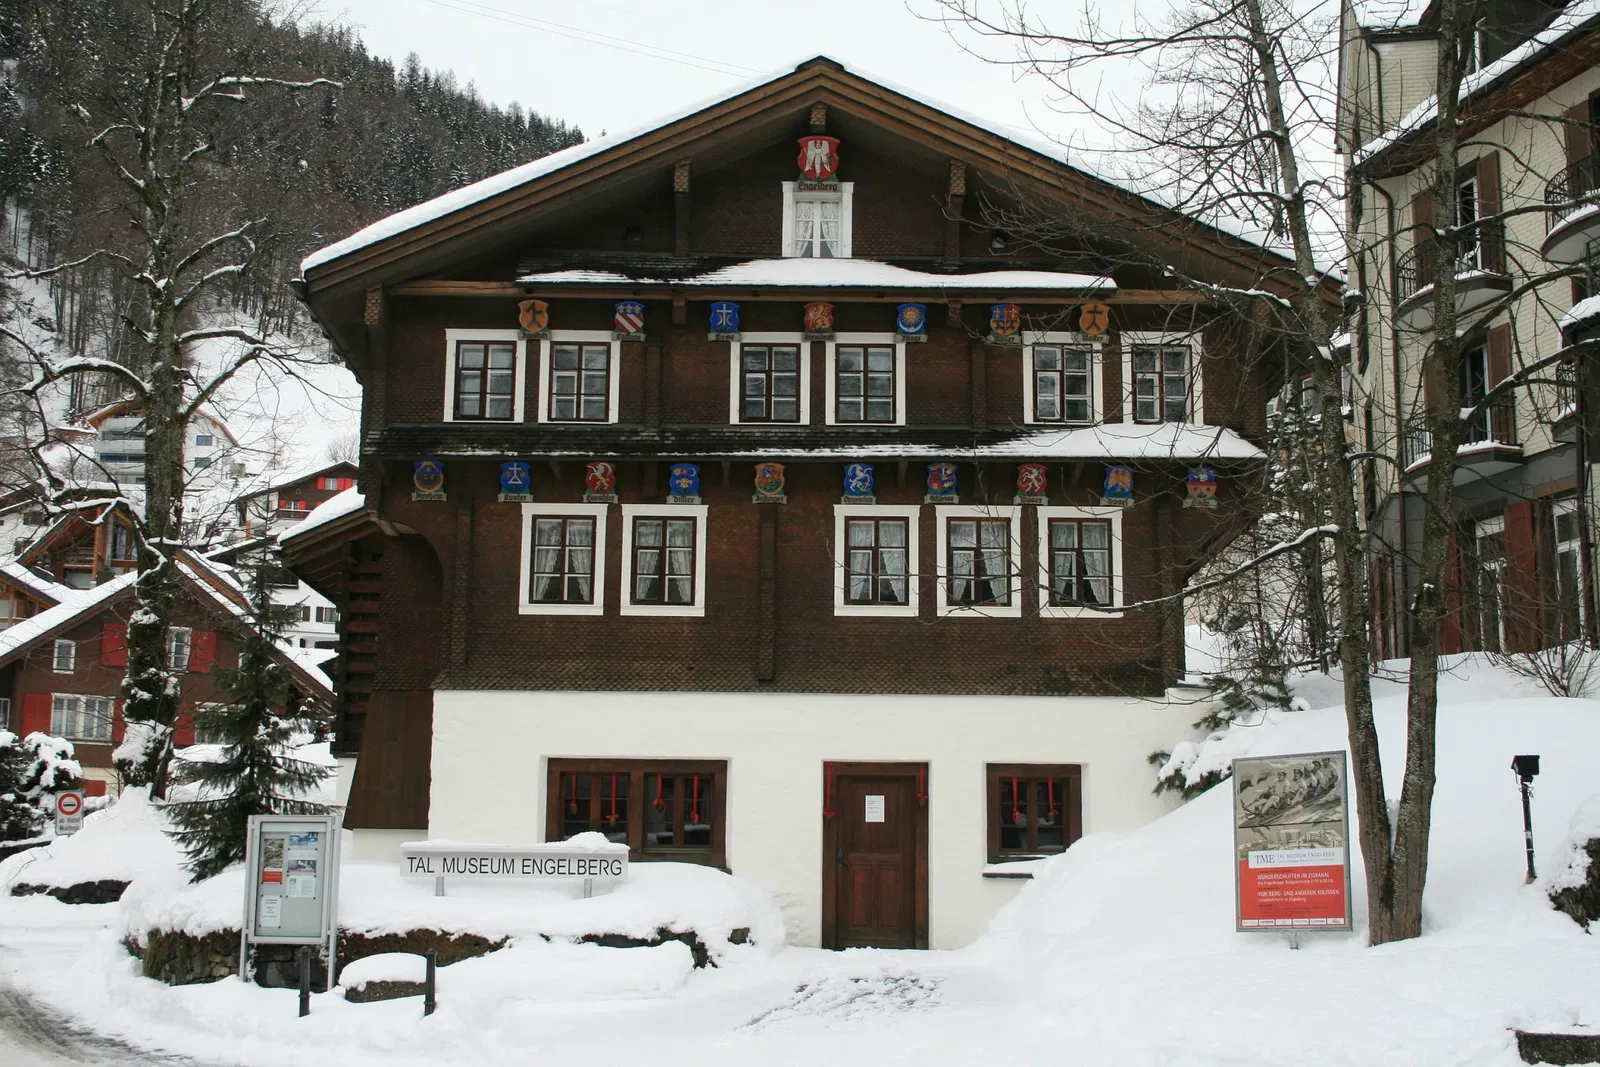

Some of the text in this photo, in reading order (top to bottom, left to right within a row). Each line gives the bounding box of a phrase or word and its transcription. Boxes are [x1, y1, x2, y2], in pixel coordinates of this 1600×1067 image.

[798, 181, 837, 191] Engelberg
[1254, 854, 1276, 864] TME
[407, 856, 622, 876] TAL MUSEUM ENGELBERG
